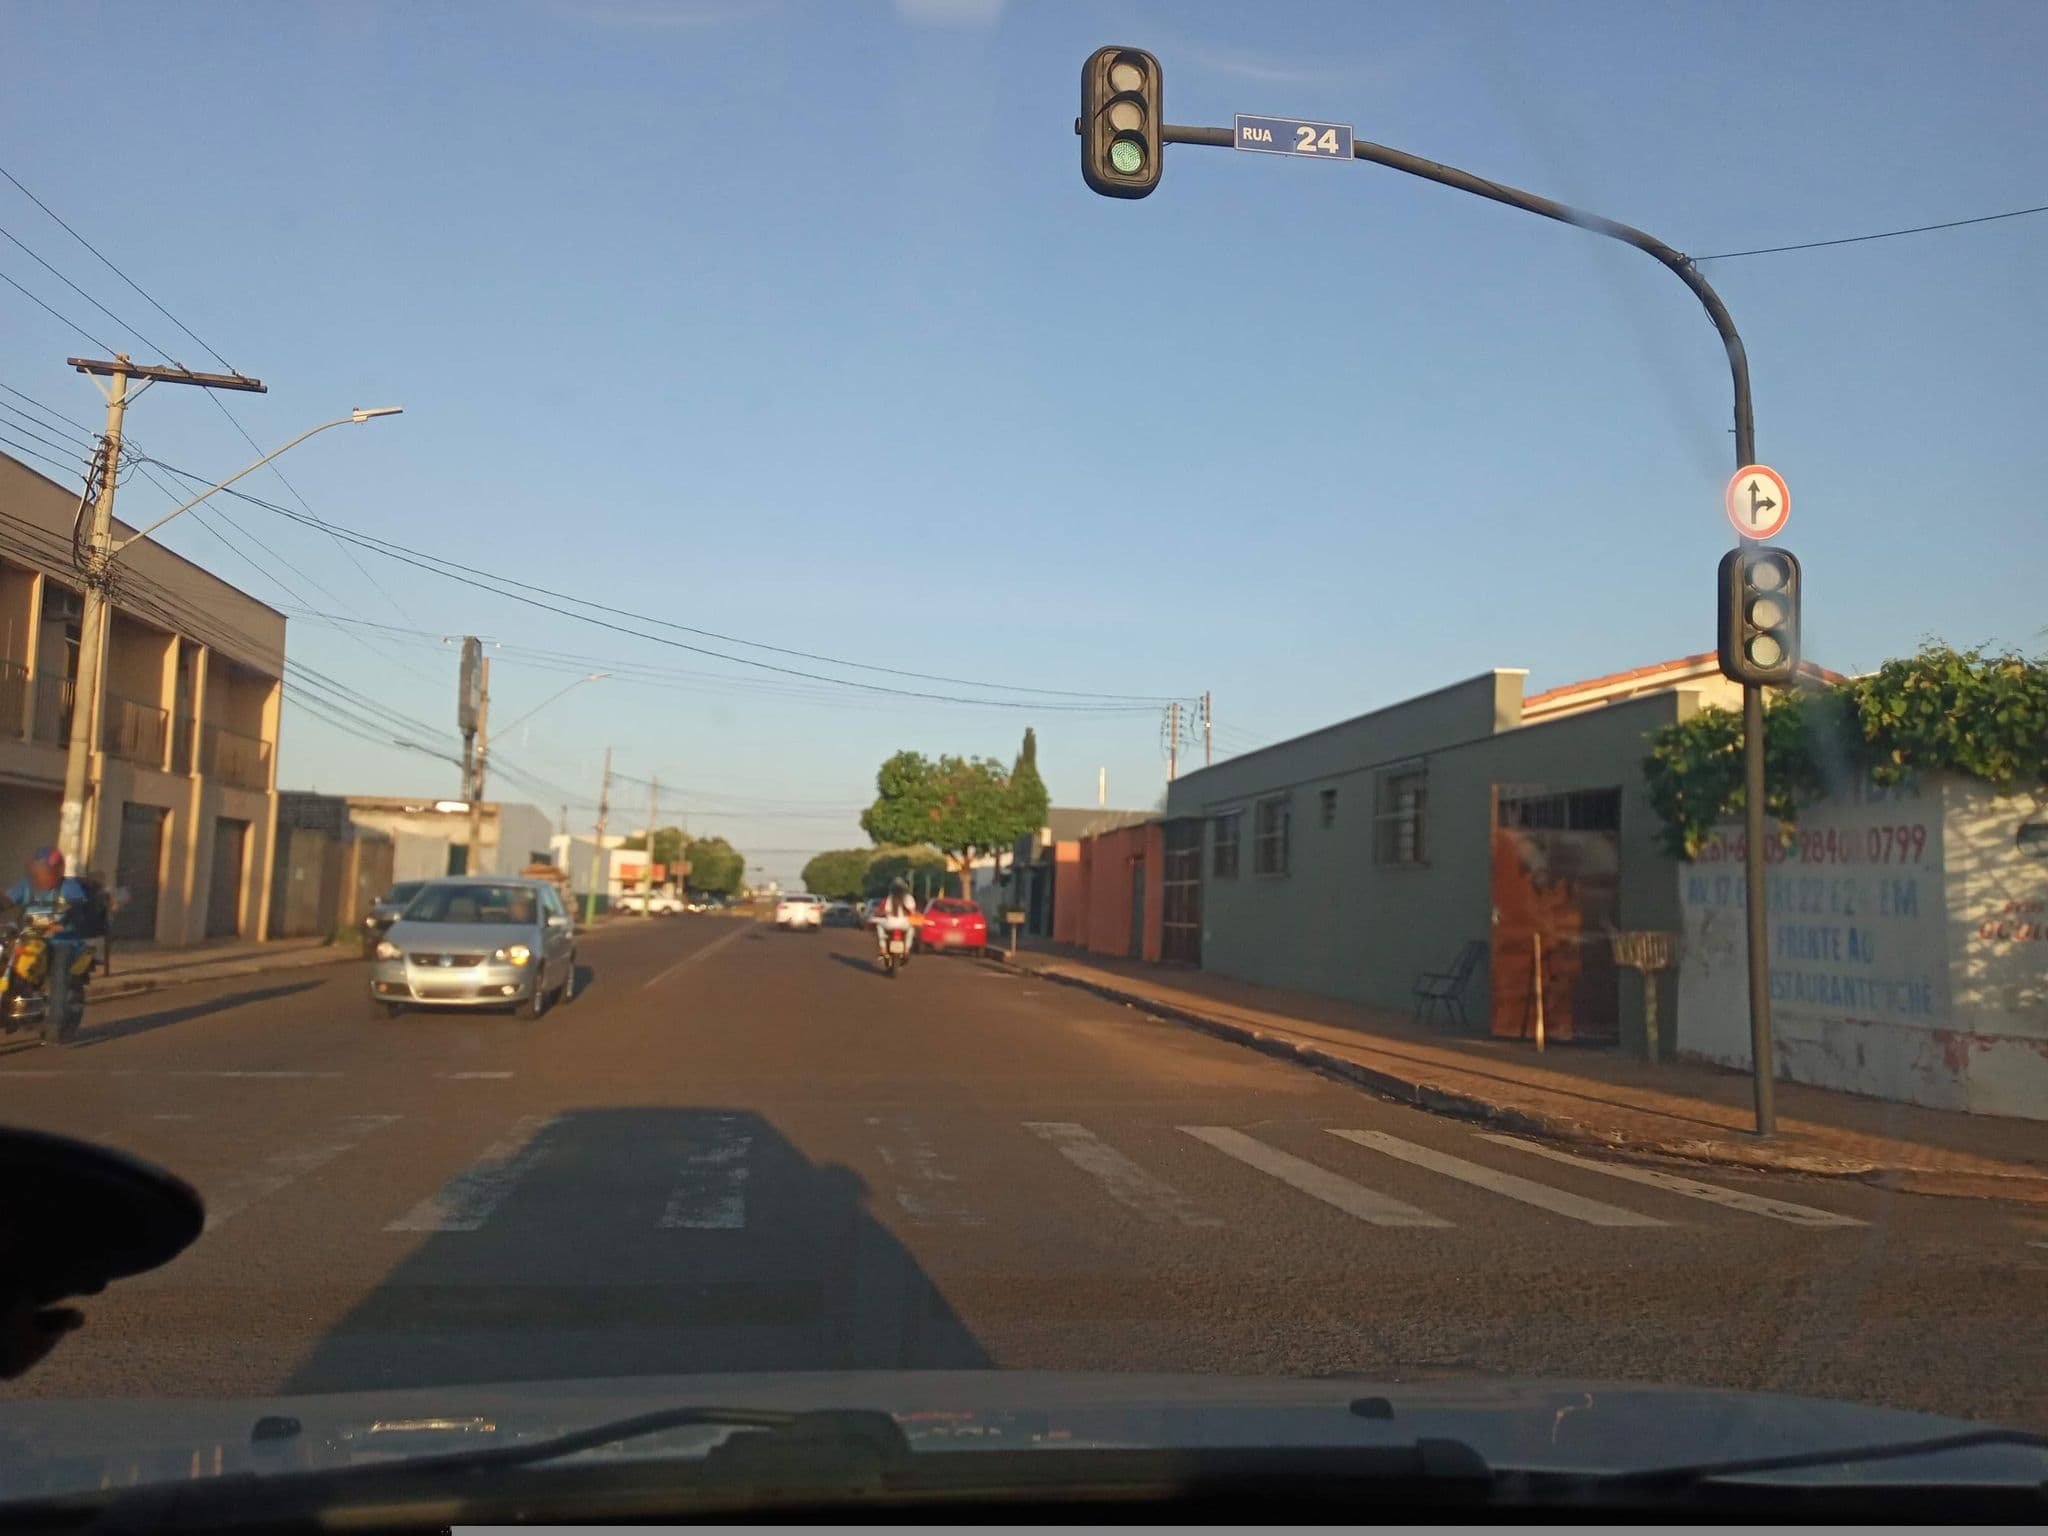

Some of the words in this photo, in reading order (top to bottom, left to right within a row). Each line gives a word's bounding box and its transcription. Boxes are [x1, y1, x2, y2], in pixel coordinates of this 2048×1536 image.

[1242, 127, 1272, 142] RUA
[1296, 126, 1339, 154] 24
[1866, 824, 1927, 864] 0799
